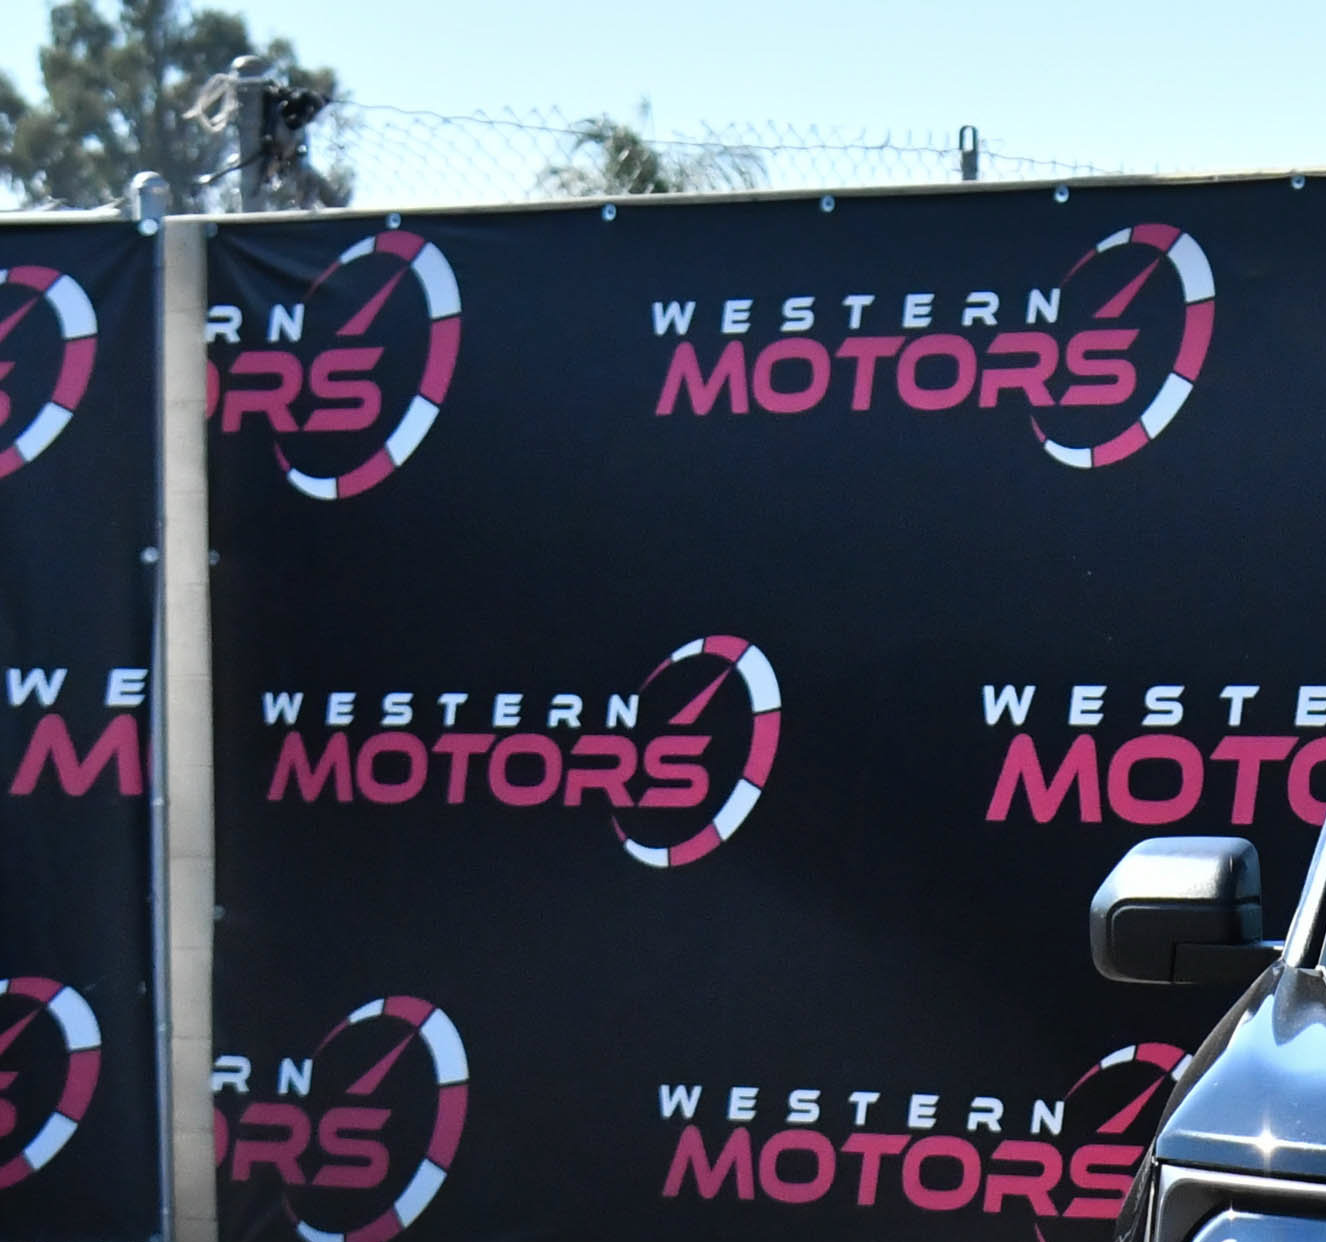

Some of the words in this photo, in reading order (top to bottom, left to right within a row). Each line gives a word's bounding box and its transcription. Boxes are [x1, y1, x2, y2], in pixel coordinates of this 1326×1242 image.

[652, 287, 1061, 336] WESTERN
[207, 347, 385, 433] RS
[655, 329, 1140, 416] MOTORS
[263, 691, 639, 729] WESTERN
[267, 731, 713, 808] MOTORS
[213, 1102, 392, 1188] RS
[659, 1084, 1065, 1135] WESTERN
[662, 1126, 1145, 1220] MOTORS
